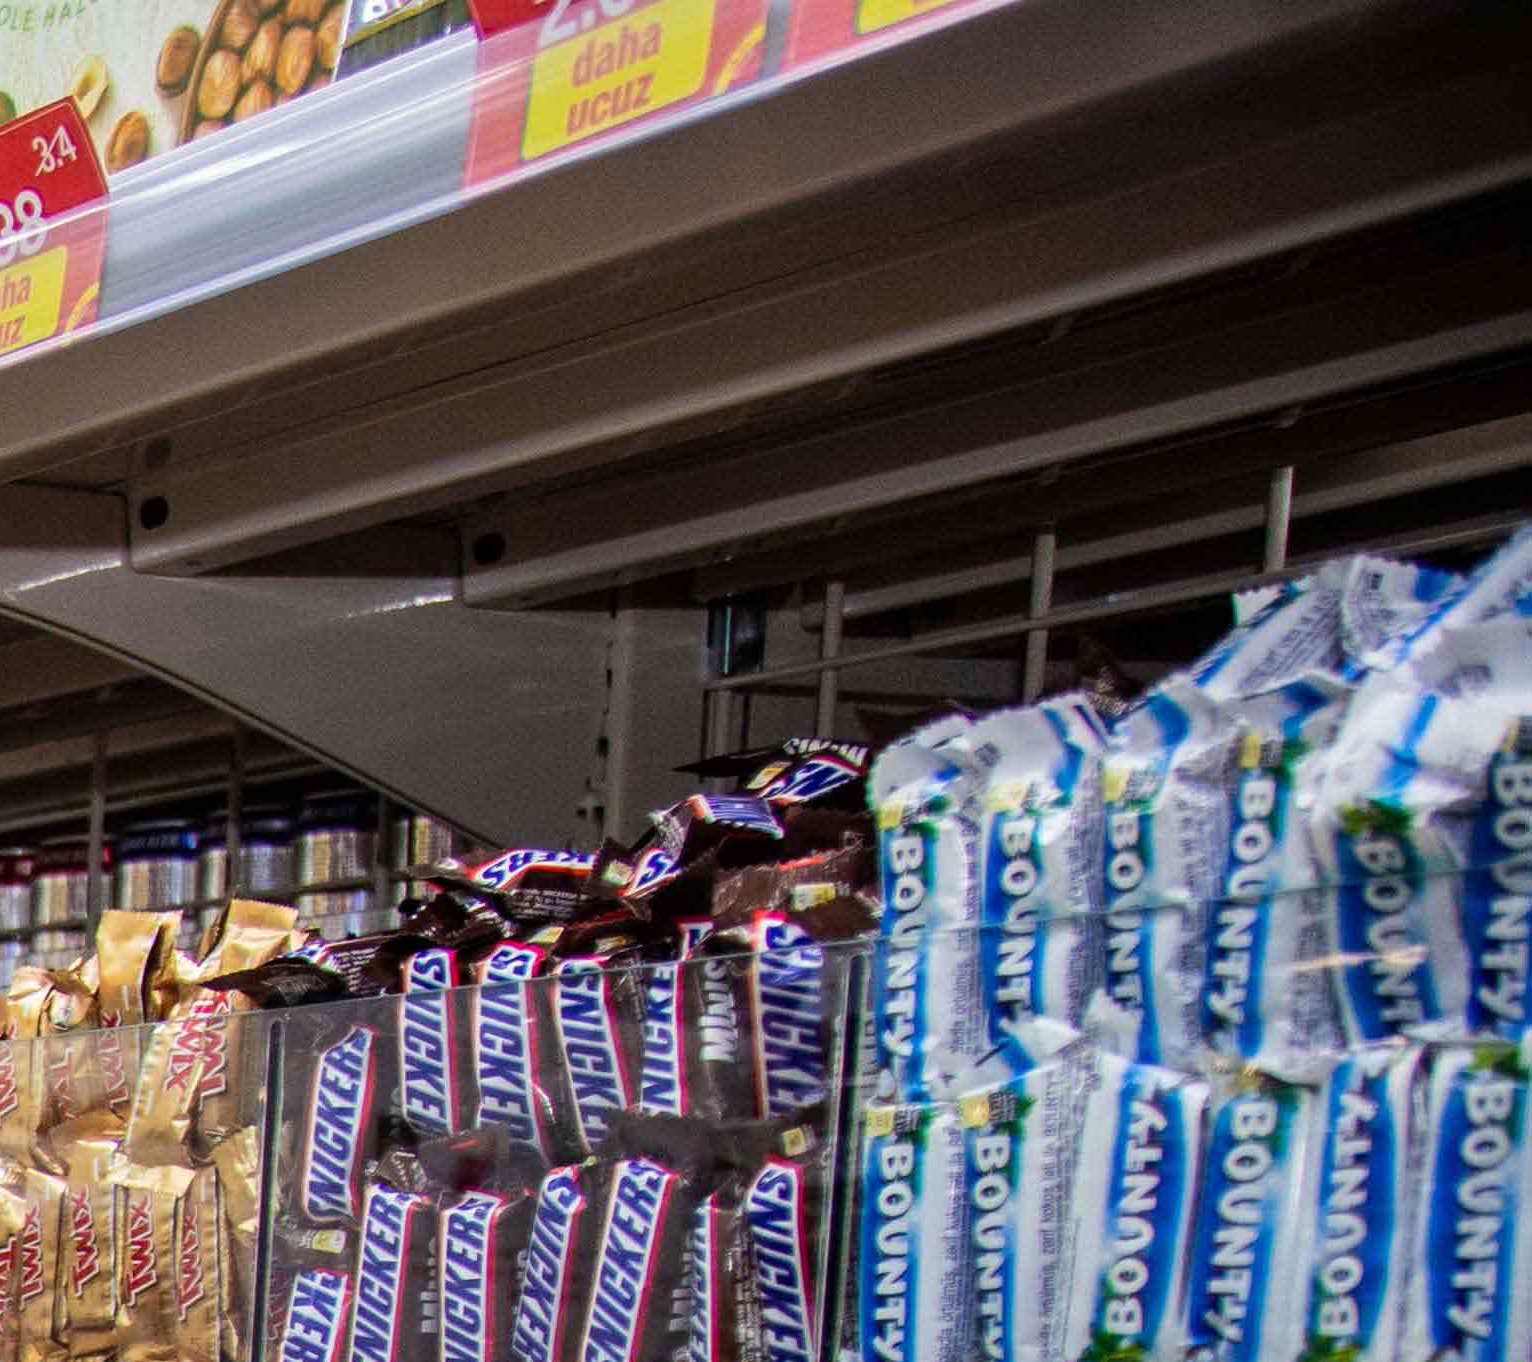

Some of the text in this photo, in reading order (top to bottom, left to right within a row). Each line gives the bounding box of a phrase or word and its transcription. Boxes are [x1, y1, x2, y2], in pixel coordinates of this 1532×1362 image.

[566, 78, 652, 138] ucuz
[571, 21, 663, 87] daha
[884, 831, 926, 1057] BOUNTY
[997, 816, 1038, 1005] BOUNT
[1108, 814, 1144, 1003] BOUNT
[1208, 777, 1276, 1024] BOUNTY
[1355, 837, 1425, 1023] BOUNT
[20, 1204, 46, 1311] TWIX
[72, 1184, 101, 1298] TWIX
[125, 1191, 158, 1308] TWIX
[179, 1213, 205, 1322] TWIX
[1107, 1100, 1167, 1335] BOUNTY
[1206, 1100, 1278, 1343] BOUNTY
[1316, 1092, 1379, 1337] BOUNTY
[1446, 1080, 1515, 1341] BOUNTY
